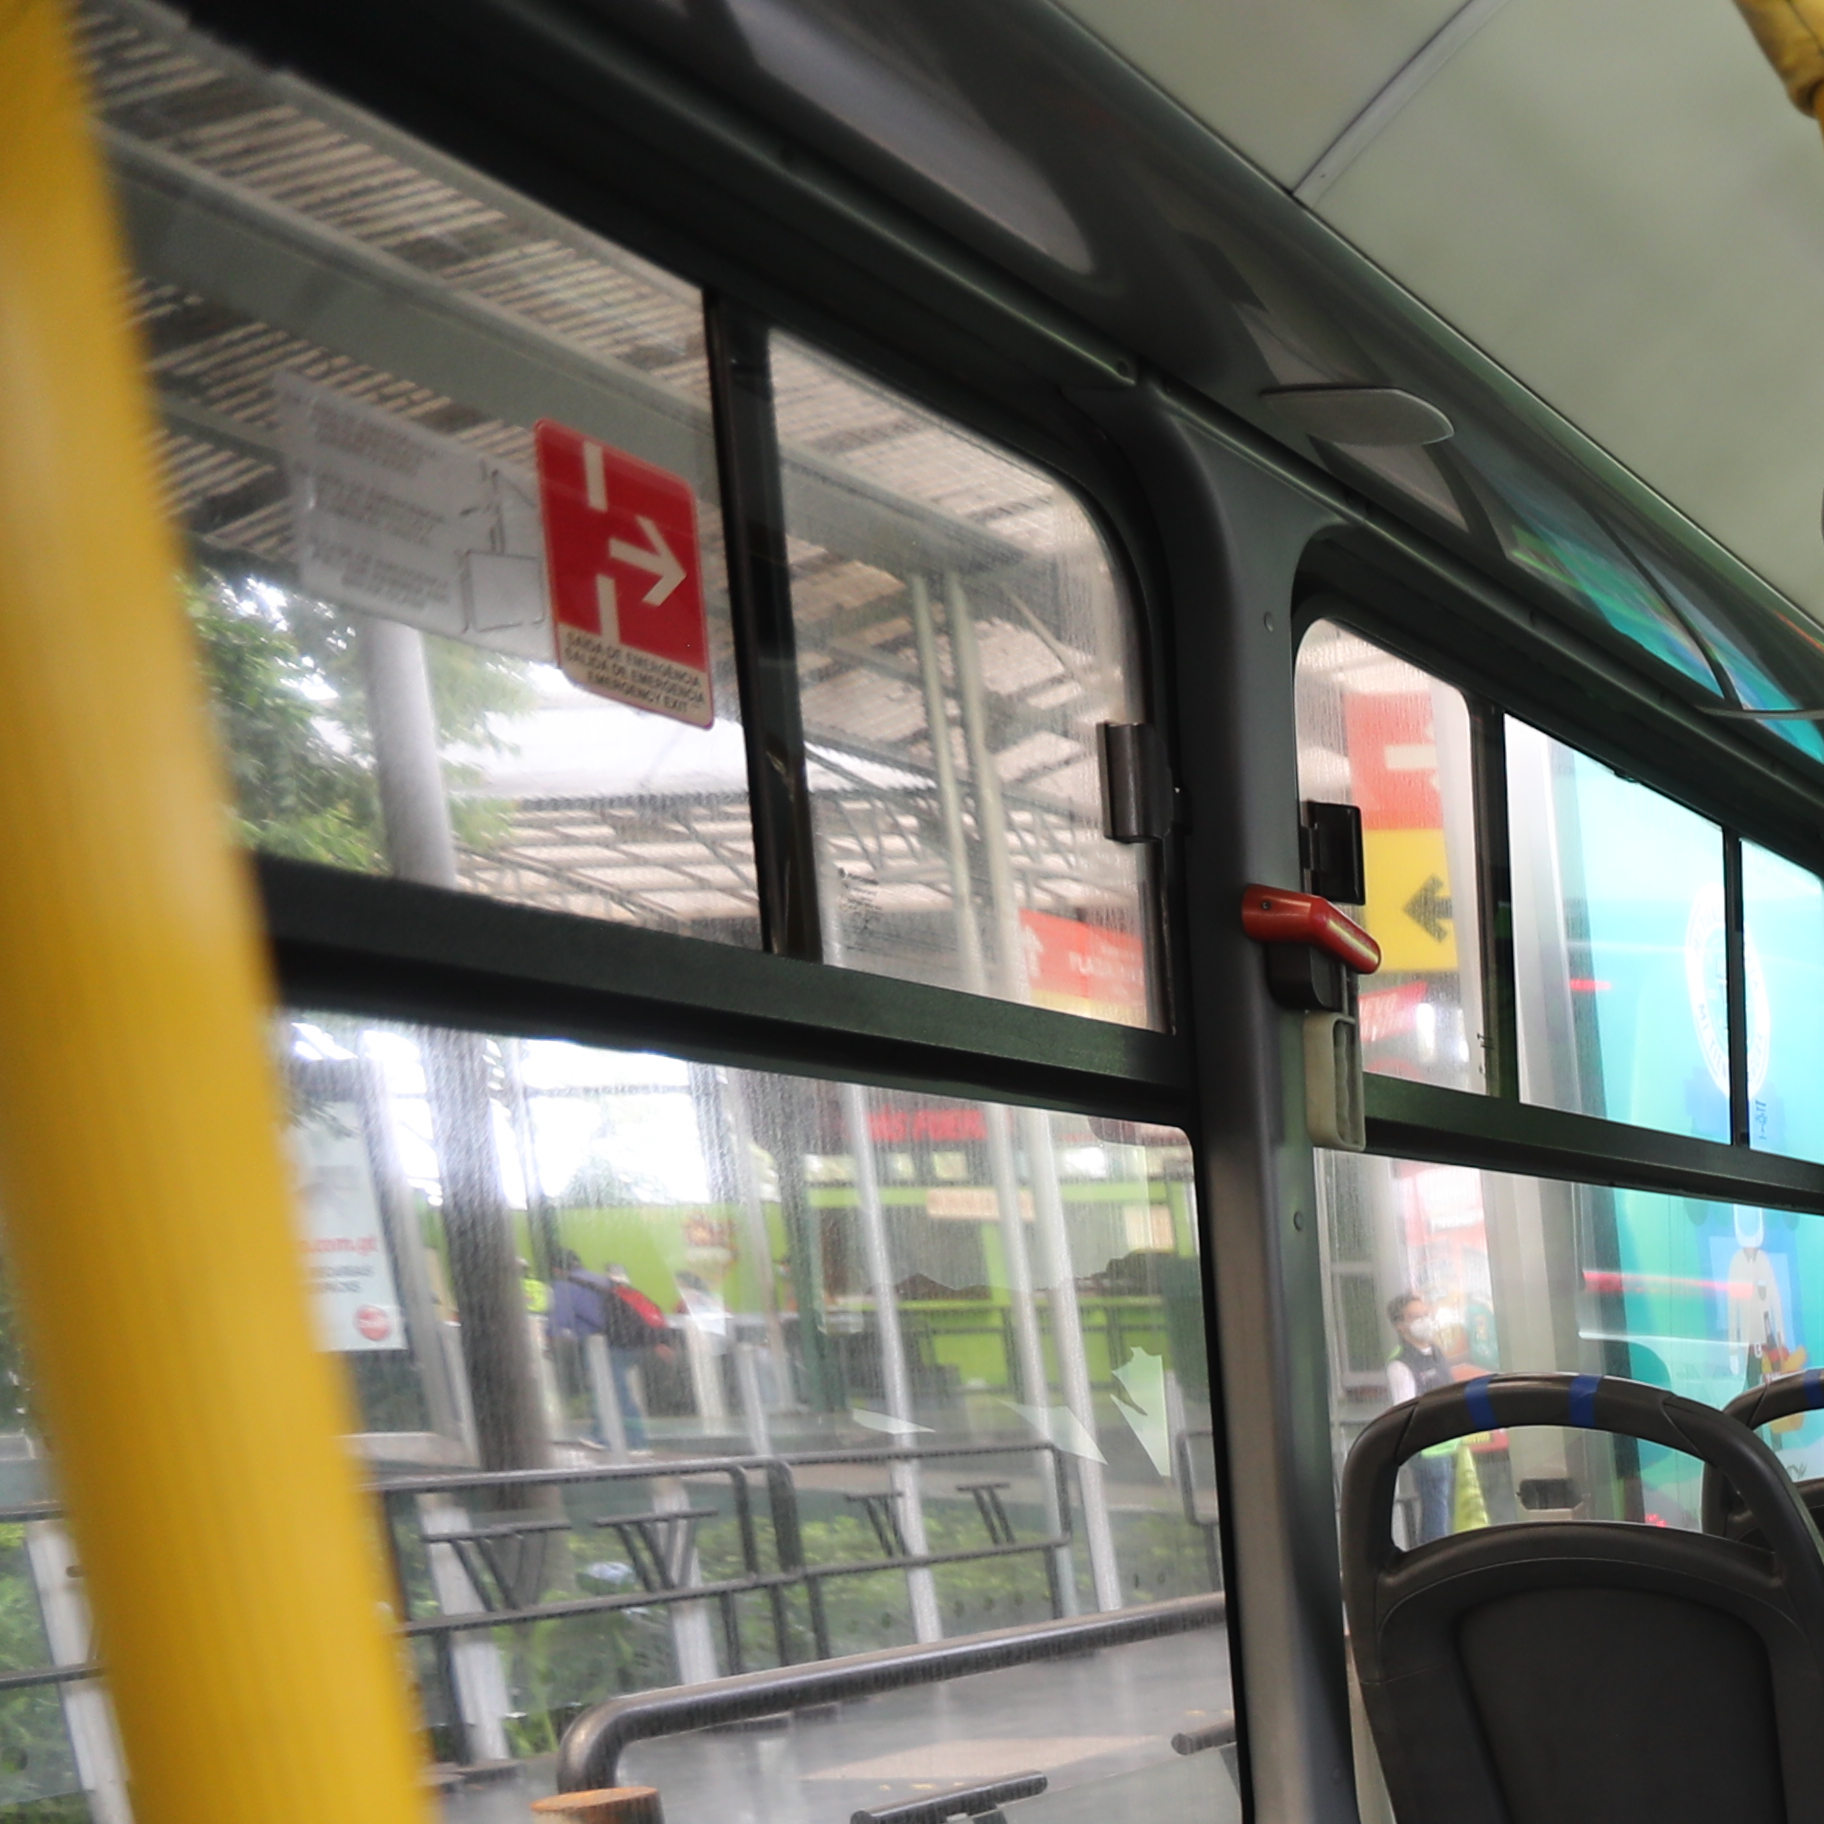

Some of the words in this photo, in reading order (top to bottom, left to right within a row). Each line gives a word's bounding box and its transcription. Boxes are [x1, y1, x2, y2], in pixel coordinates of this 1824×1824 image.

[564, 647, 607, 671] SALIDA
[611, 663, 626, 677] DE
[608, 644, 622, 660] DE
[586, 671, 662, 704] EMERGENCY
[664, 697, 688, 713] EXIT
